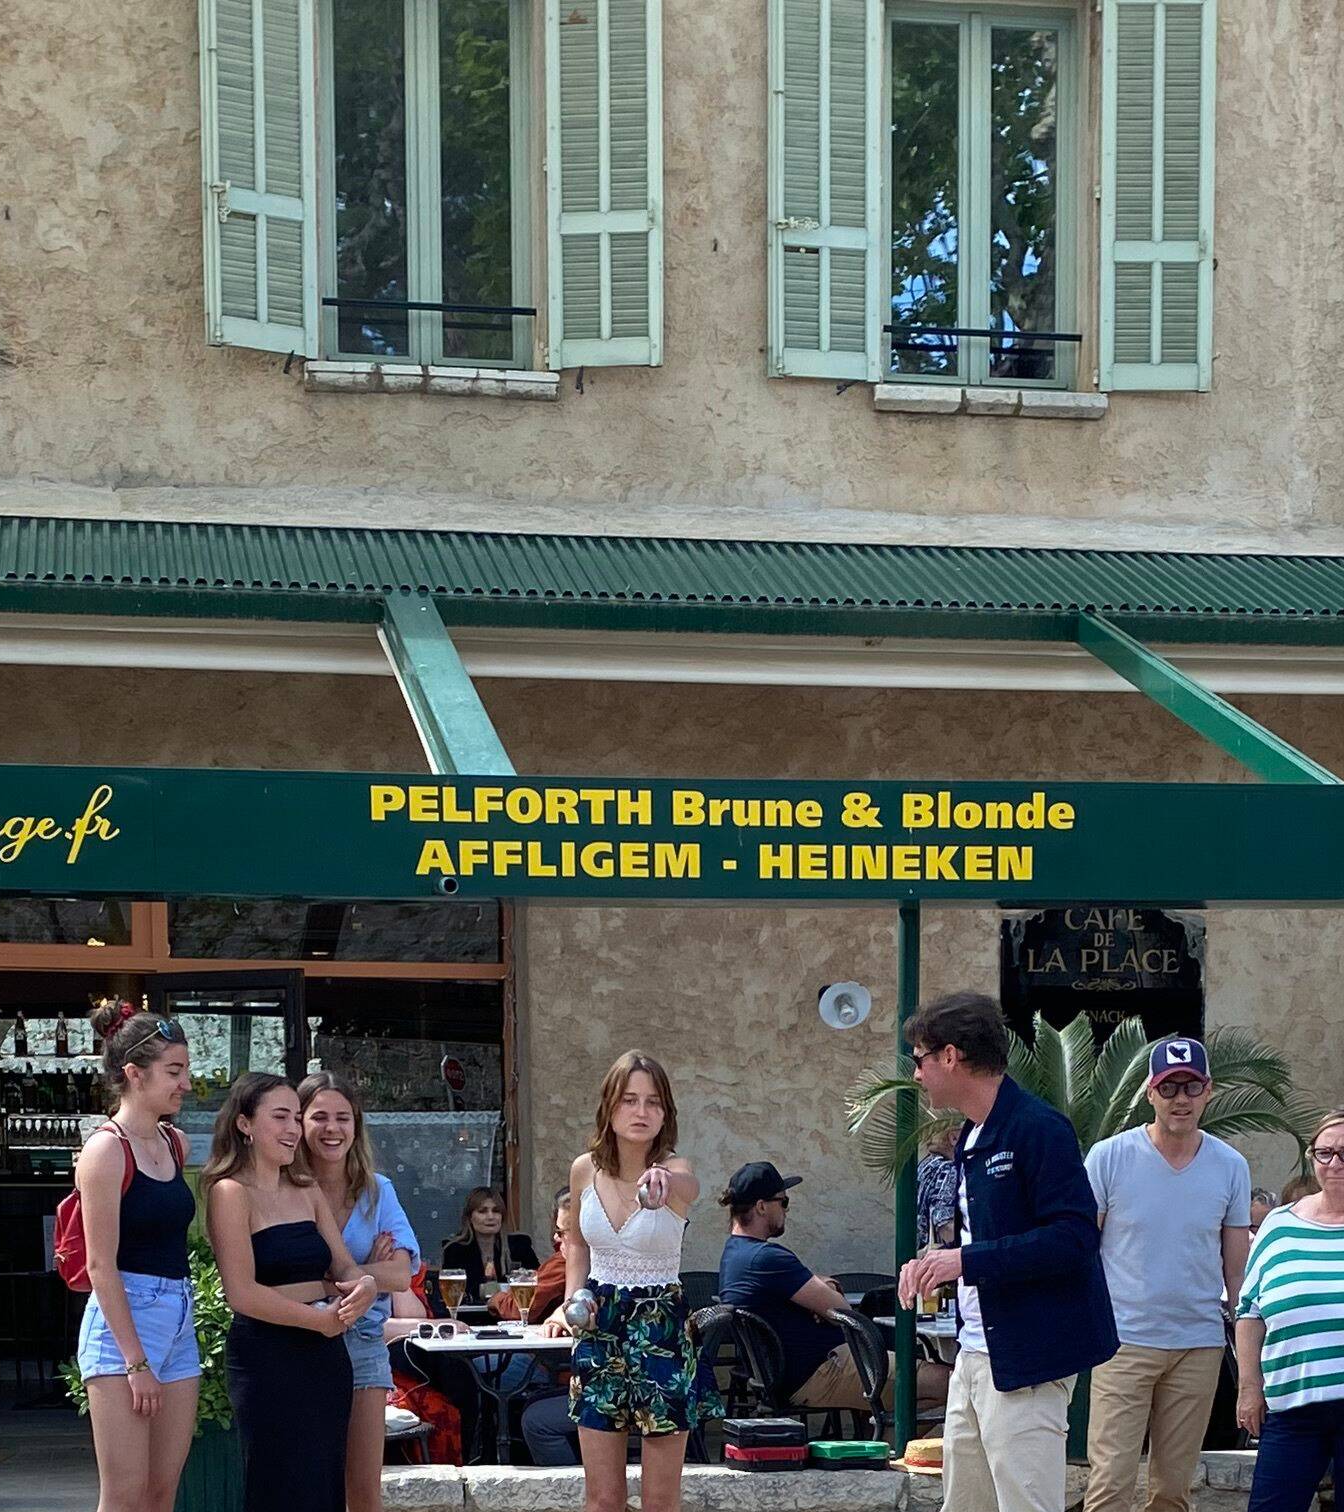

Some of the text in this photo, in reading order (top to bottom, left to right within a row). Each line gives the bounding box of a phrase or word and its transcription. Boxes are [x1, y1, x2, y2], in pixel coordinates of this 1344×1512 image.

[370, 785, 1075, 830] PELFORTH Brune & Blonde
[416, 839, 1033, 881] AFFLIGEM - HEINEKEN
[1093, 932, 1116, 948] DE
[1027, 949, 1181, 974] LA PLACE
